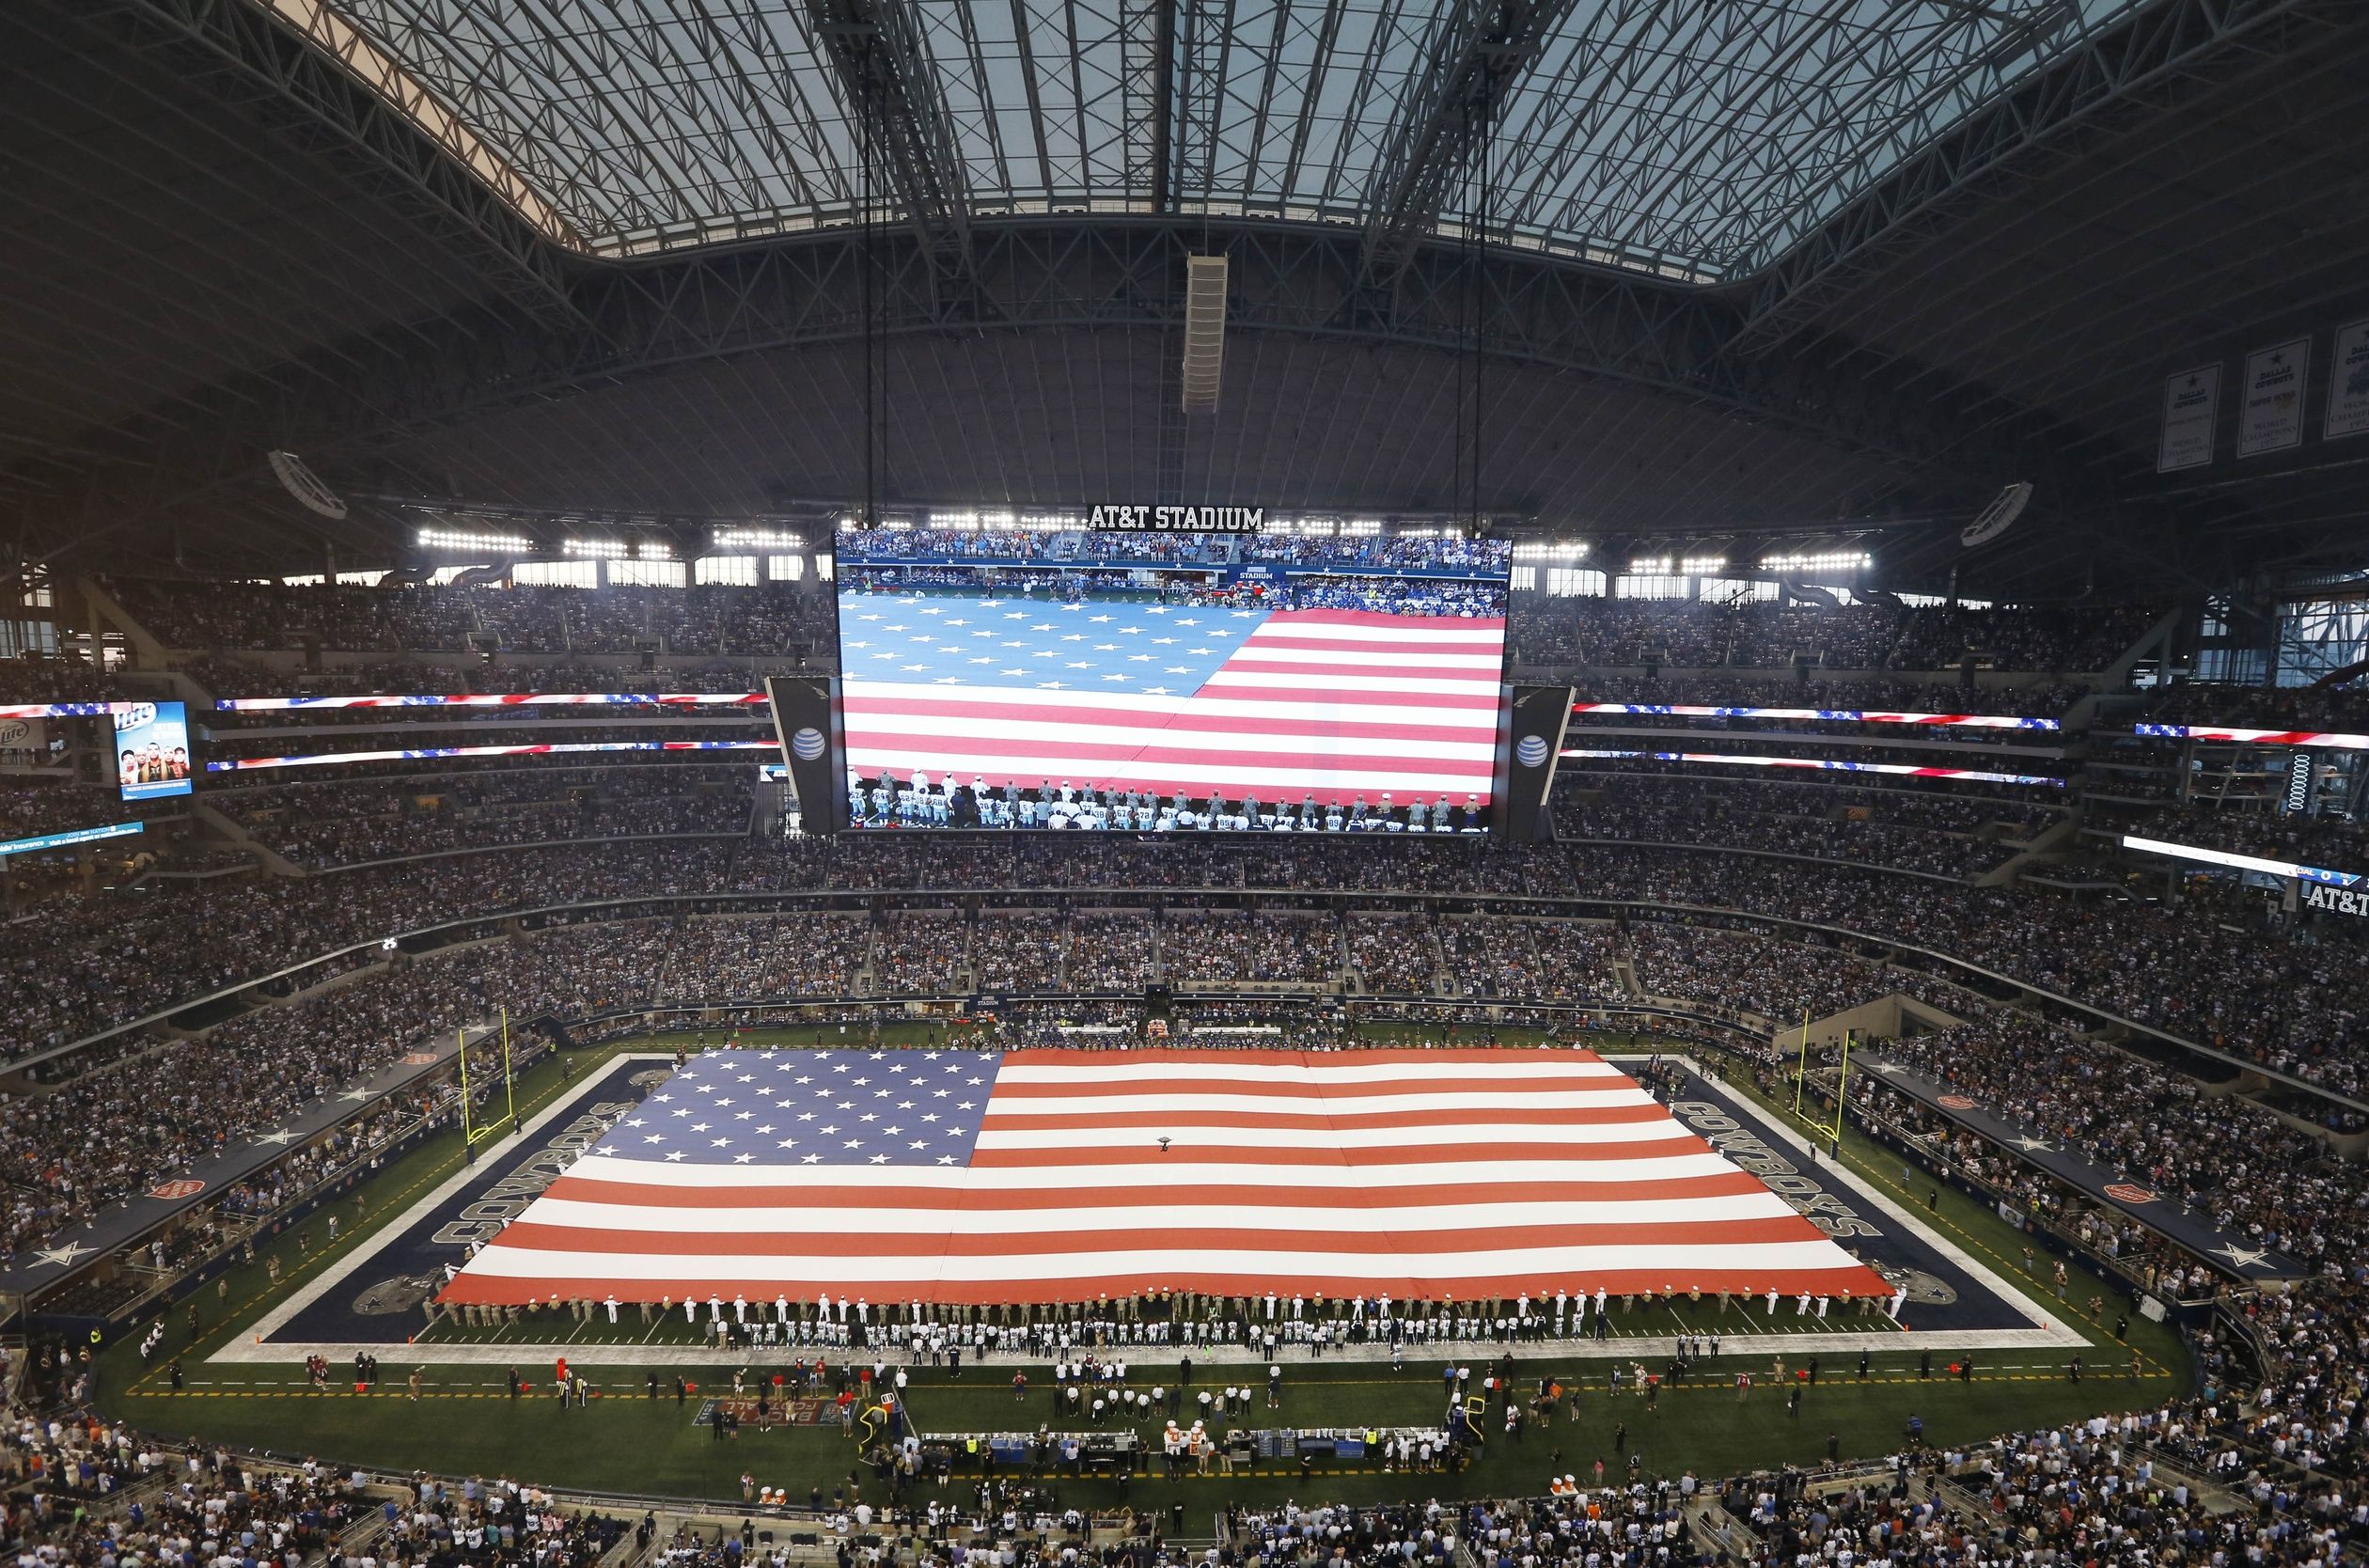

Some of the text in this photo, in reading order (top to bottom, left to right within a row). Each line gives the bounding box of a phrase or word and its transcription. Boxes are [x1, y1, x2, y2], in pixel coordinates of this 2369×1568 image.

[2260, 366, 2291, 380] DALLAS
[2255, 373, 2294, 389] COWBOYS
[2178, 388, 2205, 400] DALLAS
[2173, 396, 2208, 409] COWBOYS
[1089, 505, 1264, 530] AT&T STADIUM
[1239, 572, 1274, 580] STADIUM
[2297, 867, 2315, 877] DAL
[2307, 886, 2369, 917] AT&T
[431, 1103, 637, 1244] COWBOYS
[1673, 1101, 1884, 1238] COWBOYS
